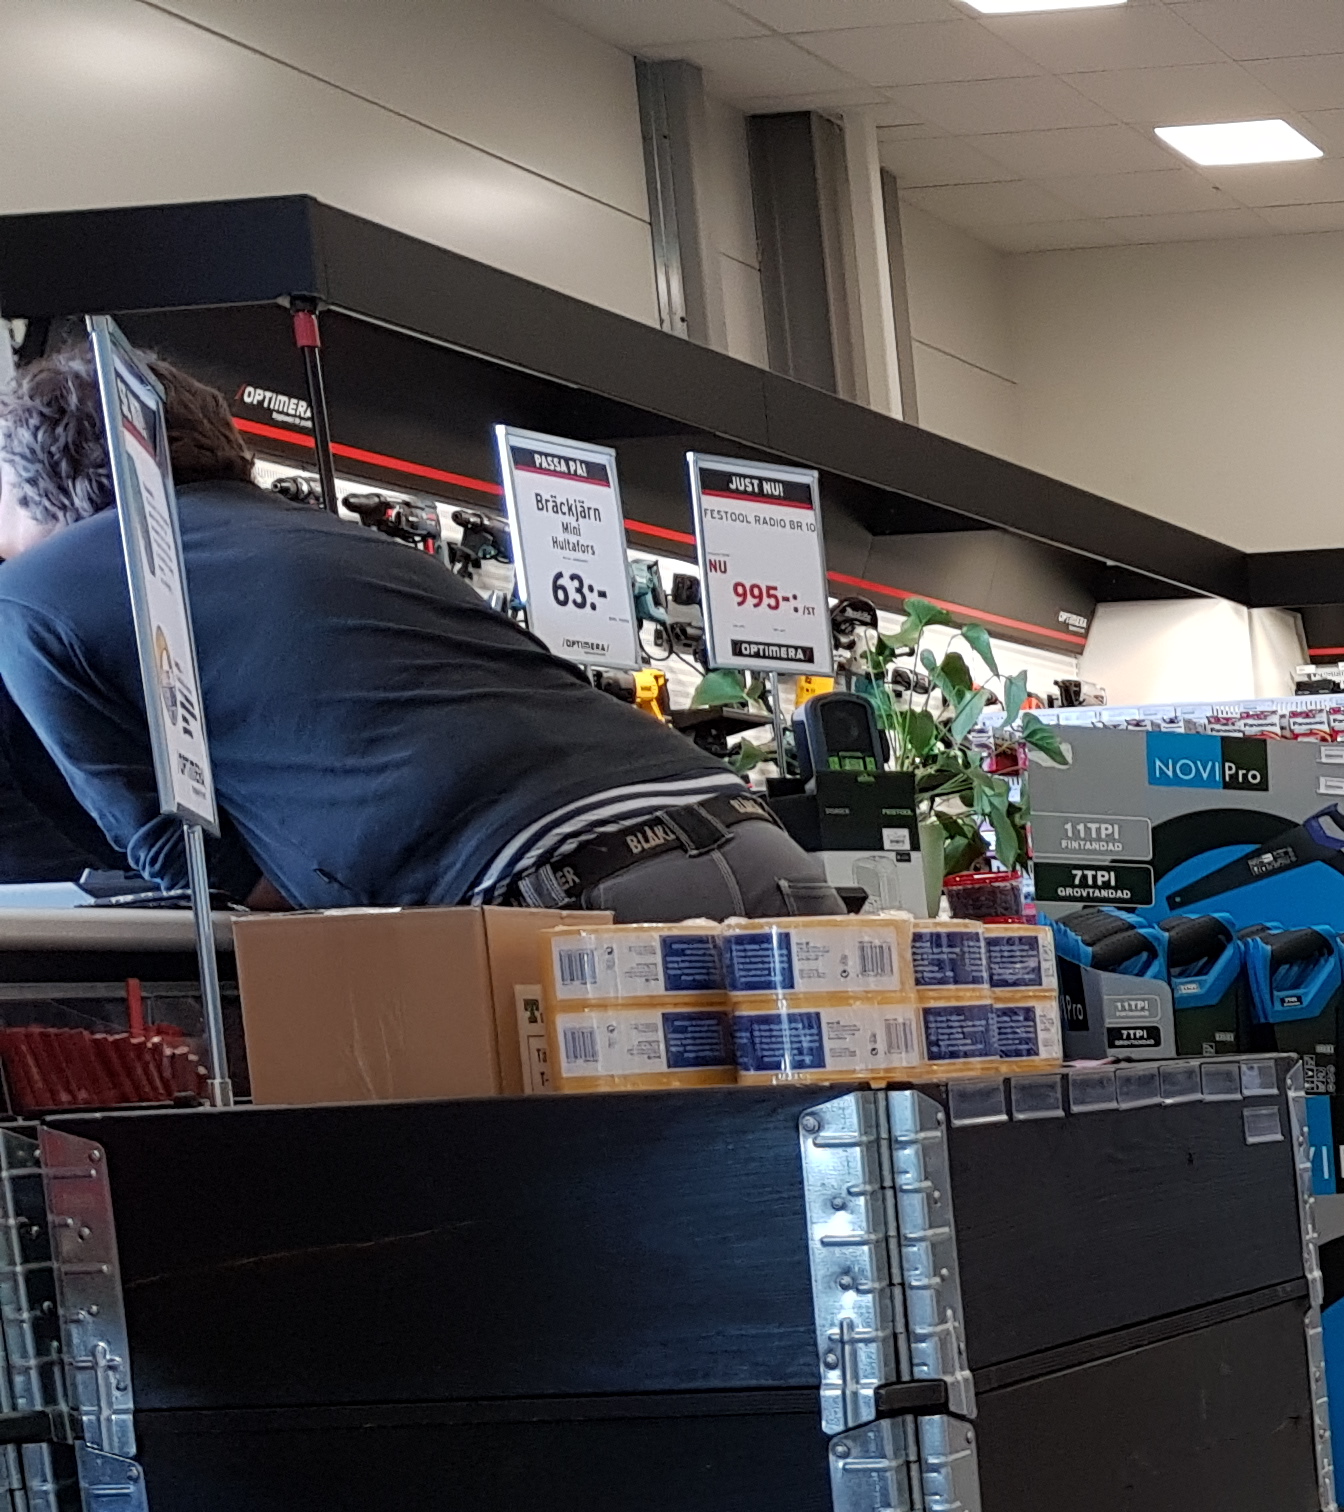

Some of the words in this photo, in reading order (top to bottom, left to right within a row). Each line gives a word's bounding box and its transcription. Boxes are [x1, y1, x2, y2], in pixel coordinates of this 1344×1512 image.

[534, 453, 568, 474] PASSA
[569, 459, 588, 478] PÅ!
[729, 476, 760, 494] JUST
[762, 480, 784, 497] NU!
[534, 492, 602, 523] Bräckjärn
[703, 508, 752, 525] FESTOOL
[754, 514, 786, 529] RADIO
[561, 521, 582, 537] Mini
[551, 536, 596, 556] Hultafors
[708, 558, 728, 574] NU
[741, 642, 805, 661] OPTIMERA
[1243, 721, 1277, 729] Panasonic
[1292, 719, 1326, 728] Panasonic
[1063, 821, 1120, 840] 11TPI
[1061, 839, 1123, 851] FINTANDAD
[1071, 869, 1116, 886] 7TPI
[1057, 887, 1131, 899] GROVTANDAD
[1060, 995, 1084, 1020] Pro
[1115, 1000, 1149, 1011] 11TPI
[1120, 1029, 1148, 1040] 7TPI
